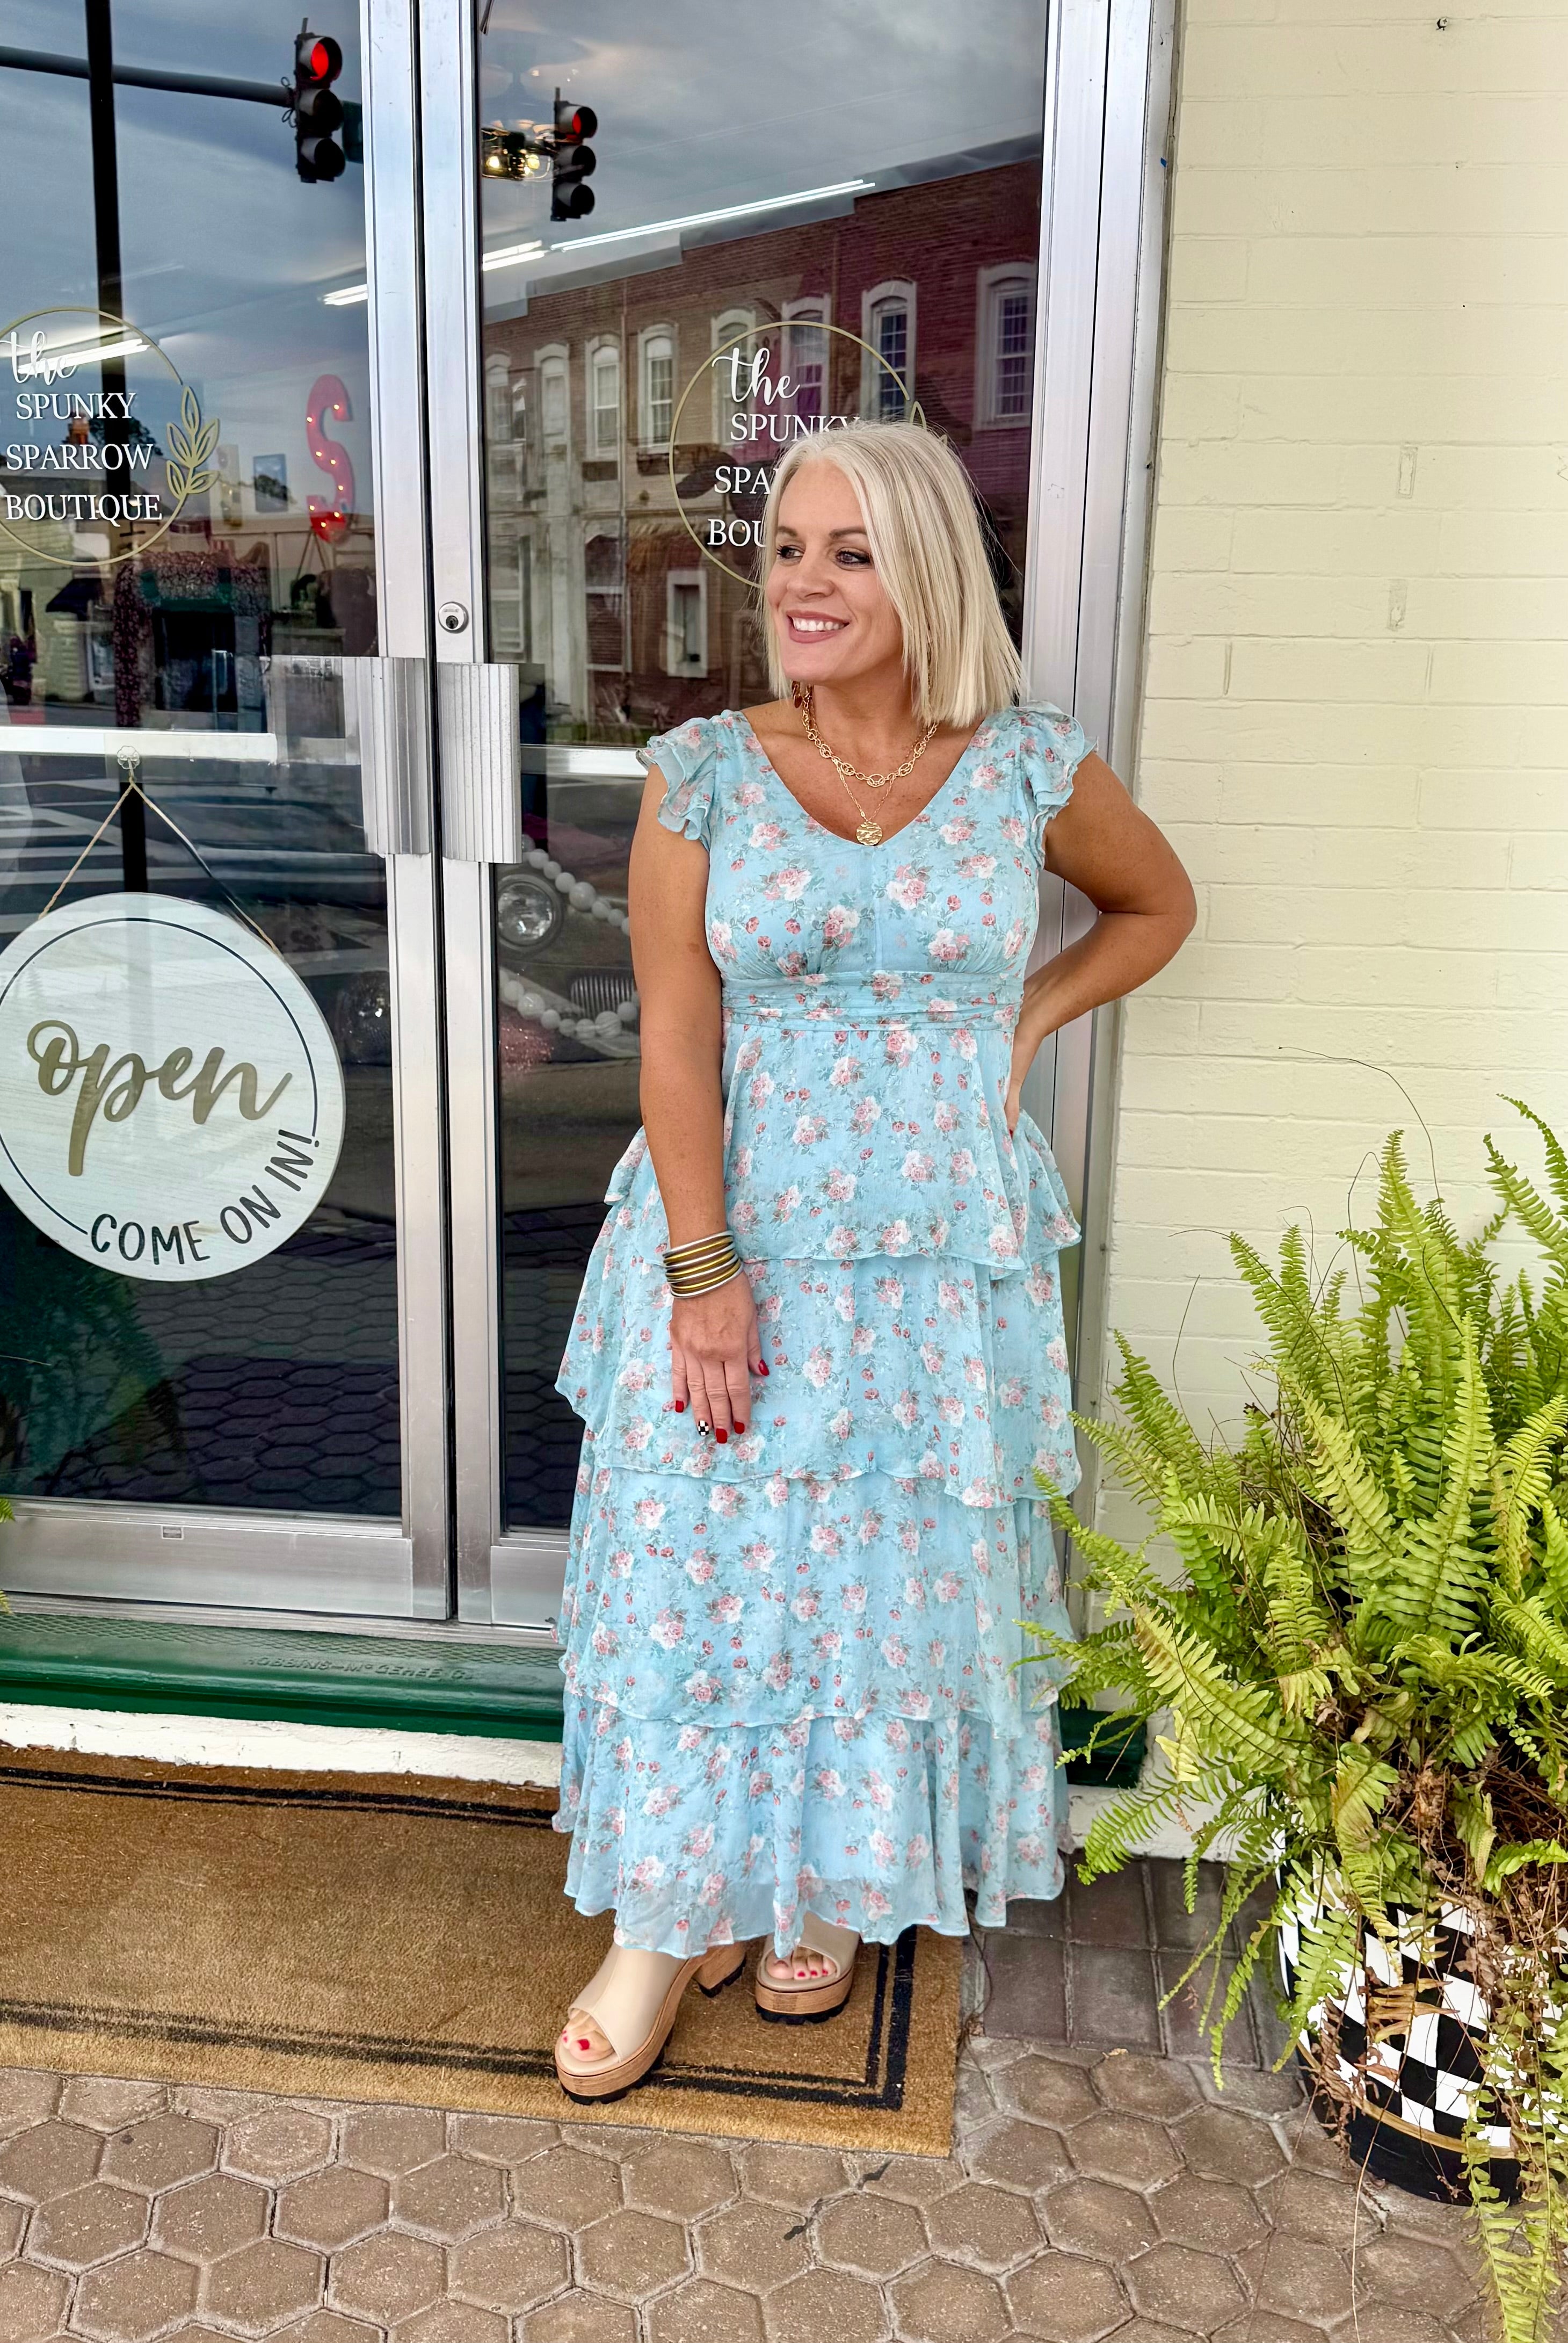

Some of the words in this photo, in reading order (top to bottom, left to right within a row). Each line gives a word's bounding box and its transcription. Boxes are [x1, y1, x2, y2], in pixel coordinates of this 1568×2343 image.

[0, 331, 77, 385] the
[712, 347, 800, 406] the
[16, 393, 136, 420] SPUNKY
[6, 444, 153, 471] SPARROW
[6, 494, 162, 527] BOUTIQUE
[27, 1020, 292, 1176] open
[91, 1213, 210, 1265] COME
[220, 1185, 281, 1244] ON
[265, 1130, 320, 1191] IN!
